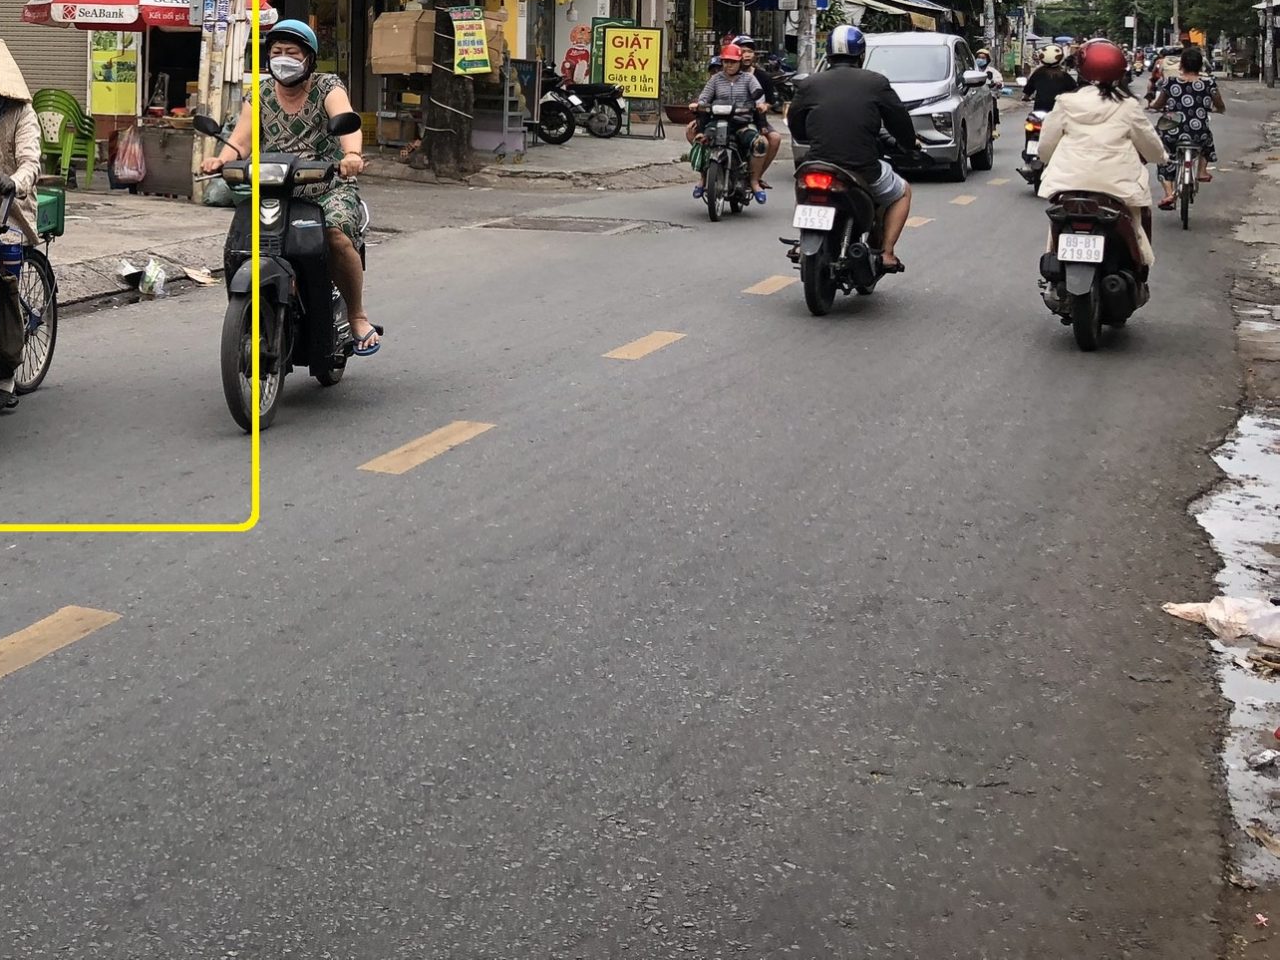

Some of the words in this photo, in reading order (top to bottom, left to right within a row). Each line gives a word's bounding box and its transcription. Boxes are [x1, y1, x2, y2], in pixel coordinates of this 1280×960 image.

[78, 7, 125, 19] SeABank
[611, 33, 654, 52] GIẶT
[614, 51, 649, 71] SẤY
